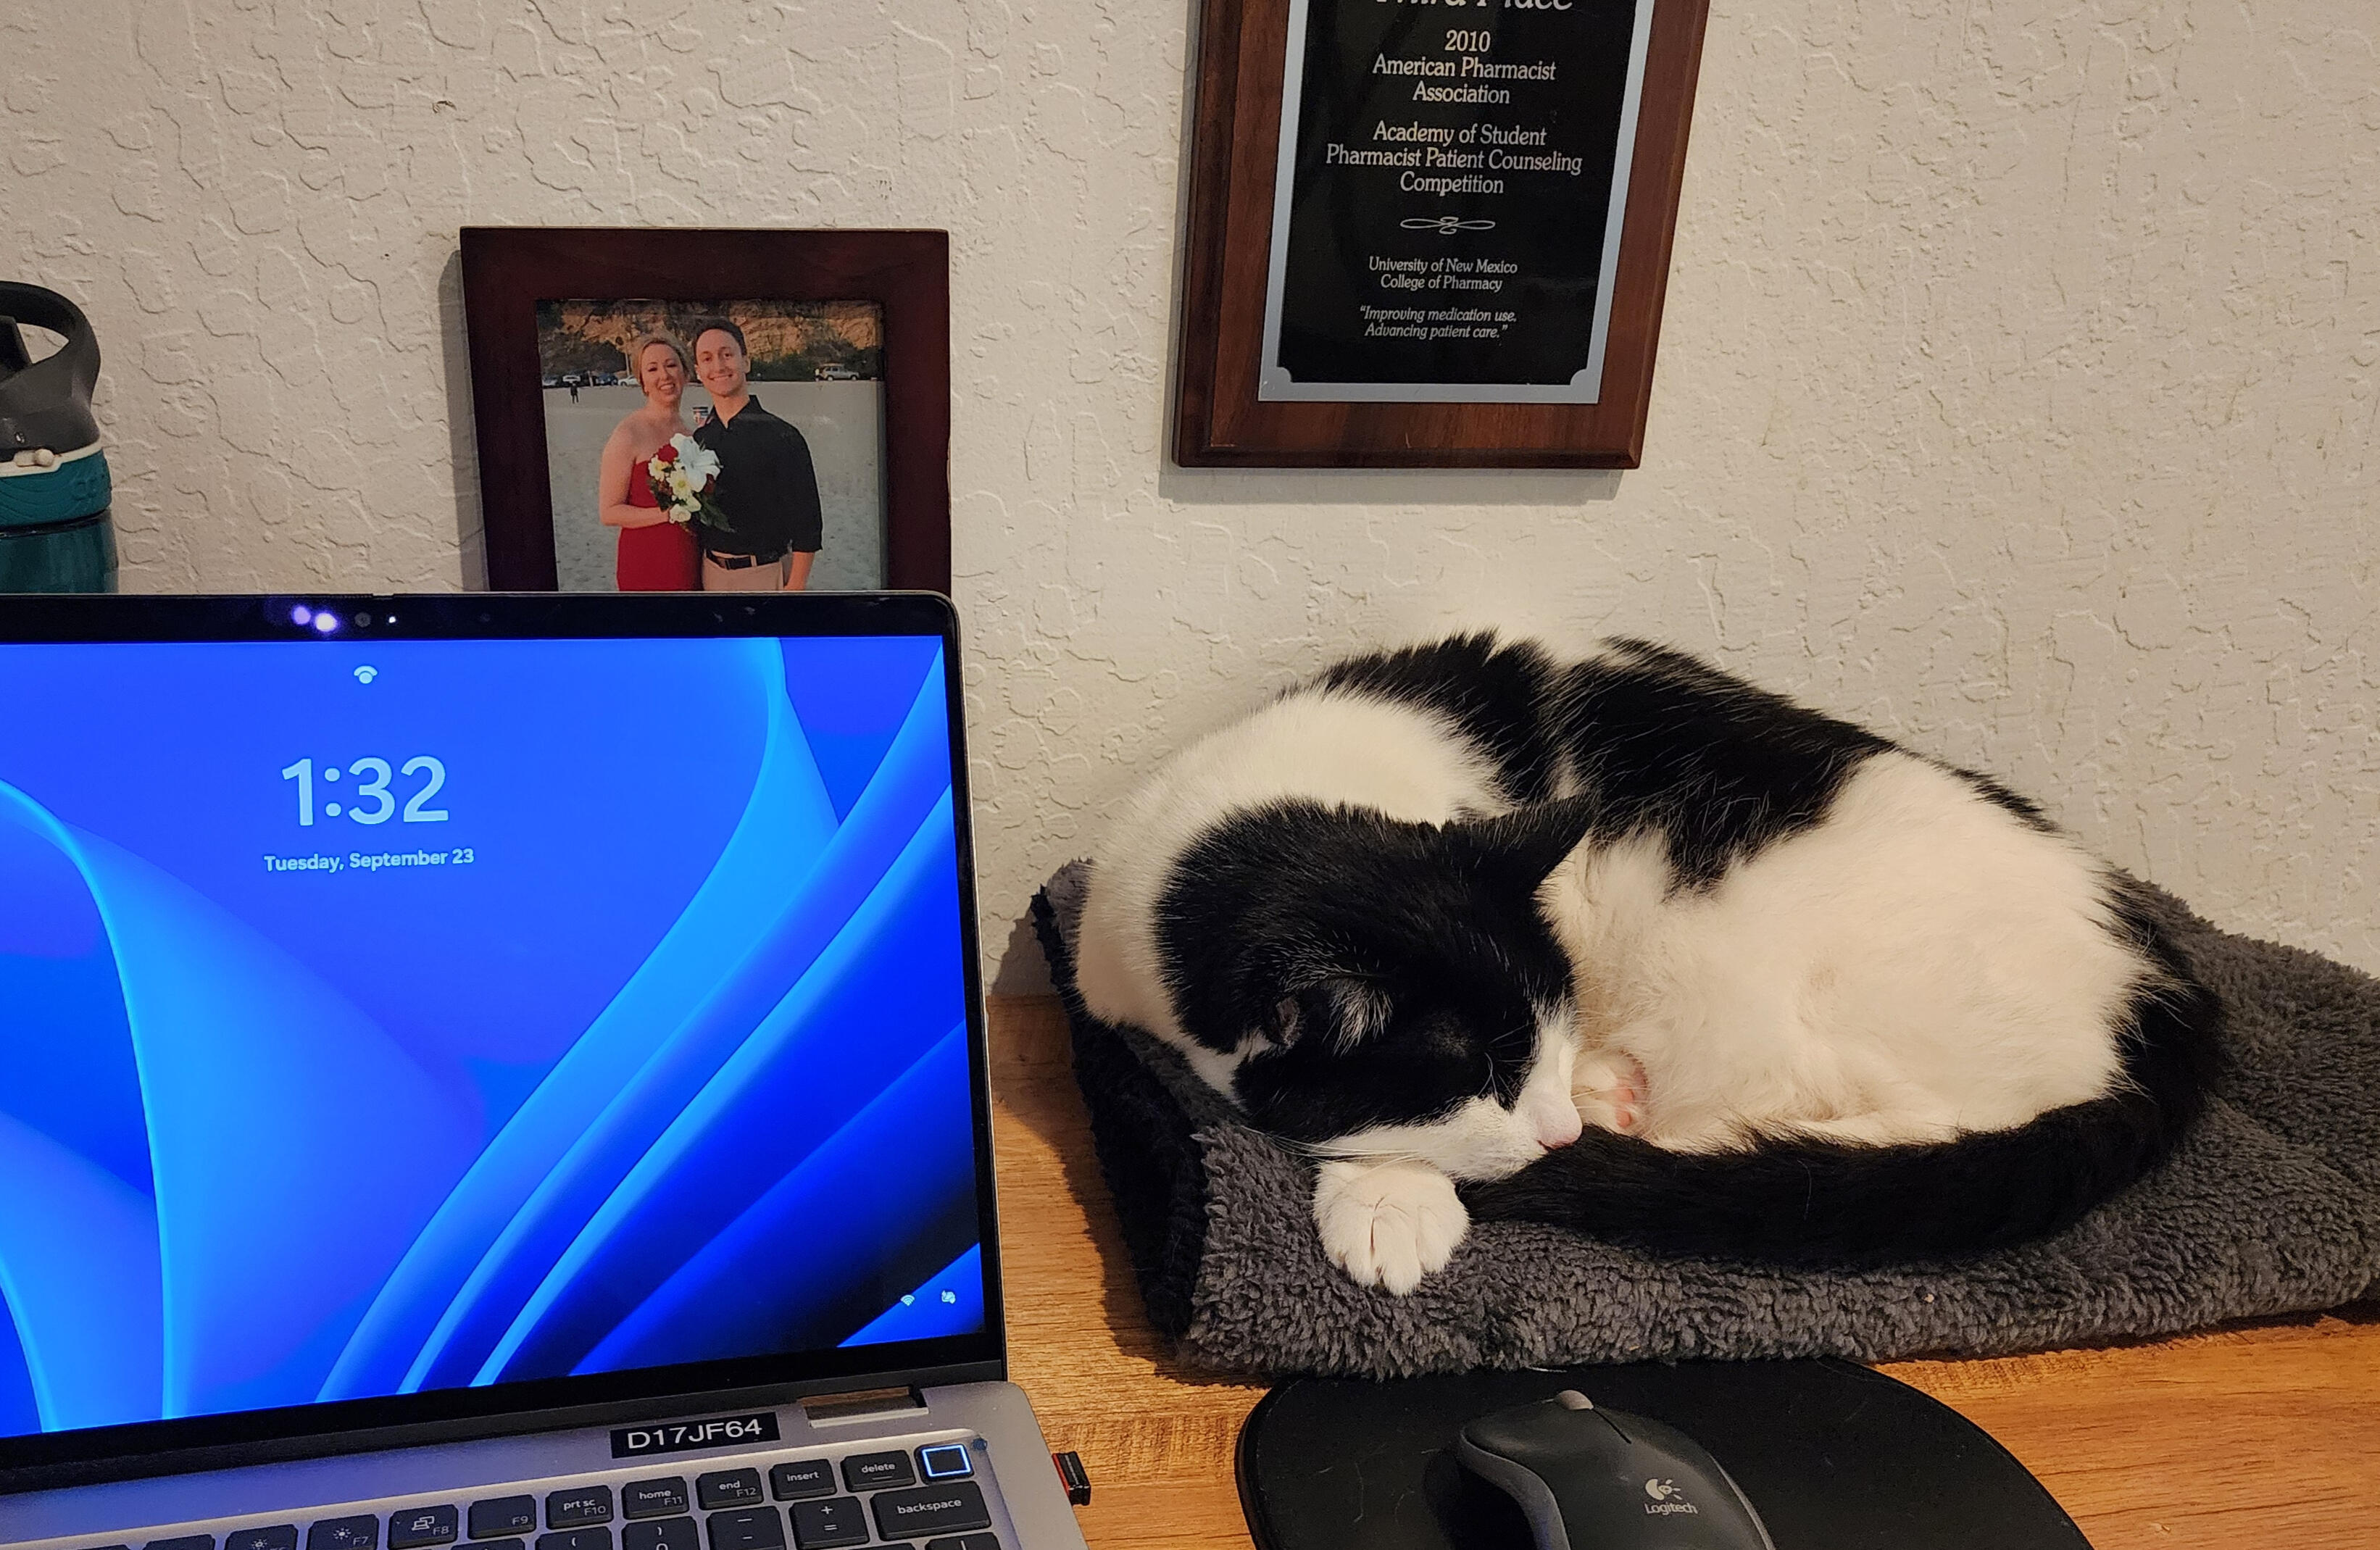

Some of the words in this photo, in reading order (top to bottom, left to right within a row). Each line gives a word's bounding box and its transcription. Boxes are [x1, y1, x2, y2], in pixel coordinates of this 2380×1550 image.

[1444, 29, 1491, 52] 2010
[1372, 53, 1456, 77] American
[1460, 56, 1557, 80] Pharmacist
[1412, 80, 1510, 104] Association
[1373, 120, 1455, 147] Academy
[1458, 122, 1478, 143] of
[1480, 123, 1547, 146] Student
[1326, 143, 1422, 167] Pharmacist
[1425, 146, 1485, 168] Patient
[1488, 149, 1583, 176] Counseling
[1399, 170, 1504, 197] Competition
[1369, 256, 1428, 275] University
[1431, 258, 1445, 272] of
[1445, 257, 1474, 273] New
[1475, 258, 1518, 274] Mexico
[1381, 272, 1426, 291] College
[1428, 274, 1442, 289] of
[1442, 275, 1503, 293] Pharmacy
[1360, 305, 1426, 324] “Improving
[1427, 307, 1491, 322] medication
[1364, 322, 1428, 340] Advancing
[1428, 325, 1471, 341] patient
[282, 756, 449, 826] 1:32
[264, 853, 344, 873] Tuesday,
[349, 849, 449, 872] September
[452, 848, 475, 864] 23
[627, 1418, 763, 1449] D17JF64
[861, 1462, 896, 1473] delete
[786, 1471, 820, 1482] insert
[718, 1480, 741, 1491] end
[736, 1487, 757, 1497] F12
[638, 1490, 672, 1501] home
[664, 1496, 683, 1506] F11
[563, 1500, 581, 1512] prt
[583, 1498, 596, 1507] sc
[583, 1505, 607, 1516] F10
[896, 1499, 962, 1514] backspace
[1644, 1501, 1699, 1516] Logitech
[512, 1516, 529, 1525] F9
[433, 1526, 449, 1536] F8
[352, 1536, 369, 1546] F7
